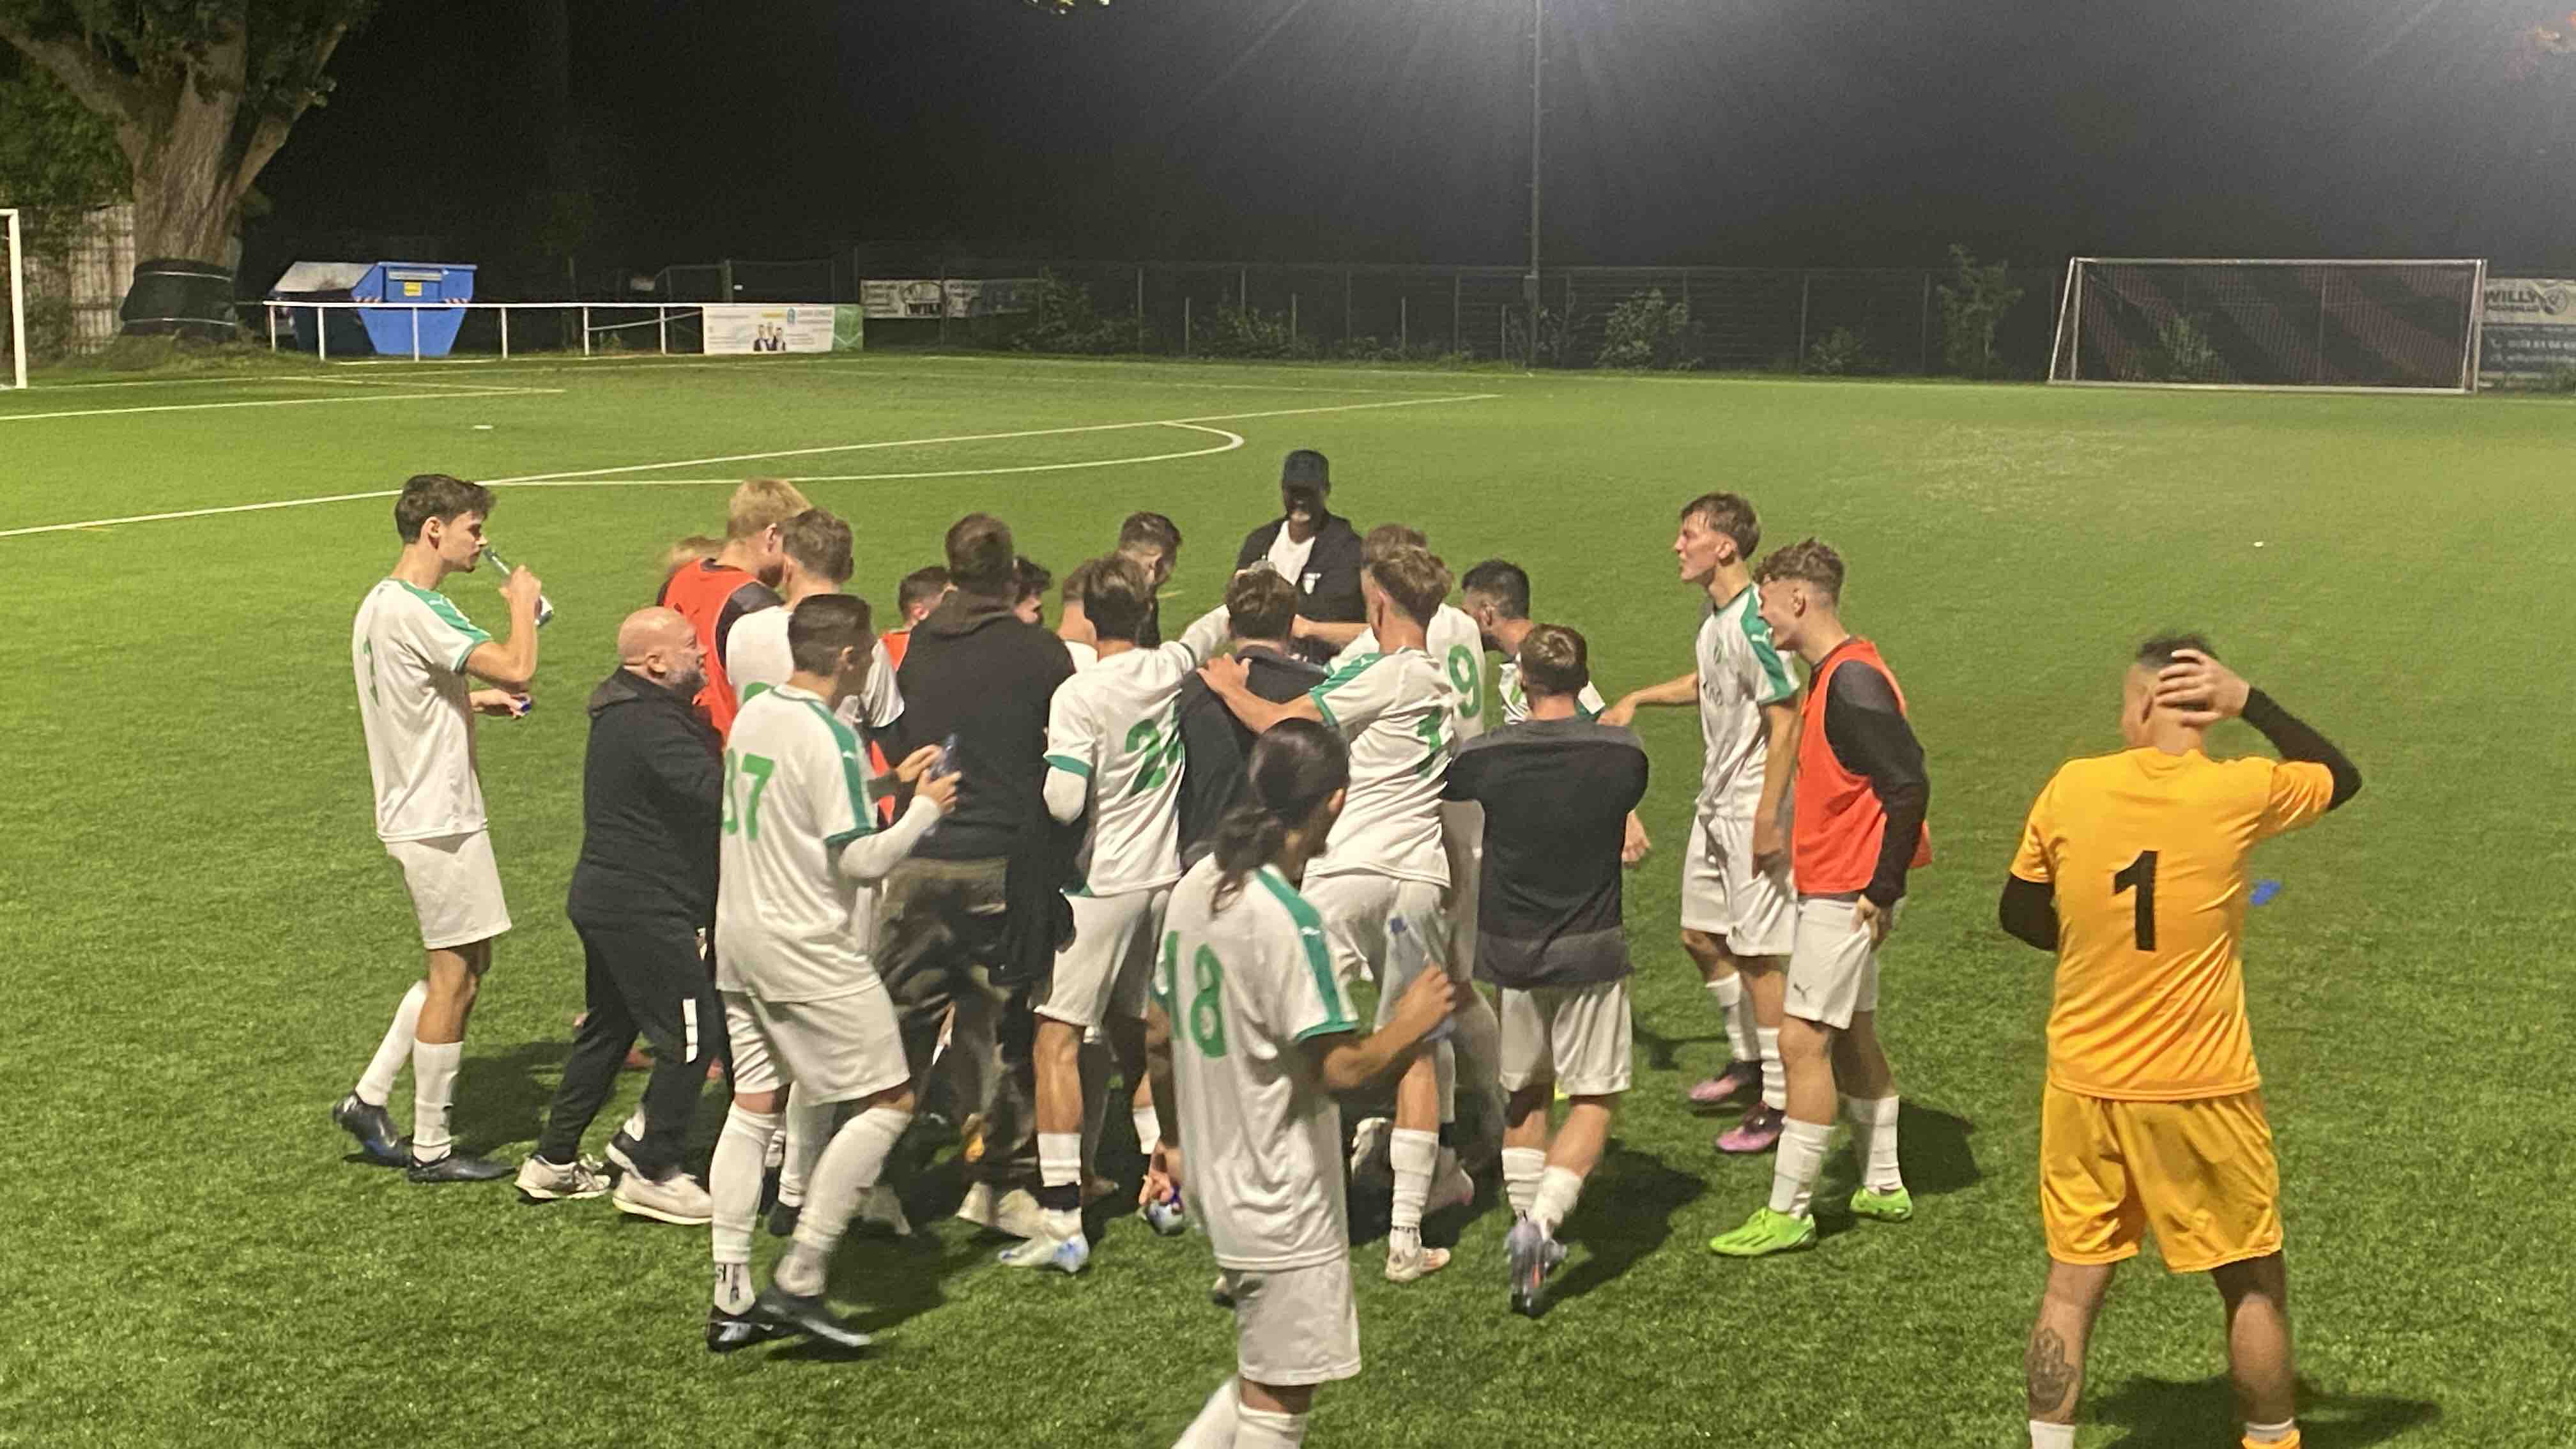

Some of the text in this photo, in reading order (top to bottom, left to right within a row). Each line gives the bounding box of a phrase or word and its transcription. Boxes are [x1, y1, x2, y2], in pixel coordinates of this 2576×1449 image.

[2485, 290, 2538, 303] WILLY
[1448, 643, 1482, 719] 9
[2113, 849, 2160, 952] 1
[1164, 930, 1227, 1059] 18
